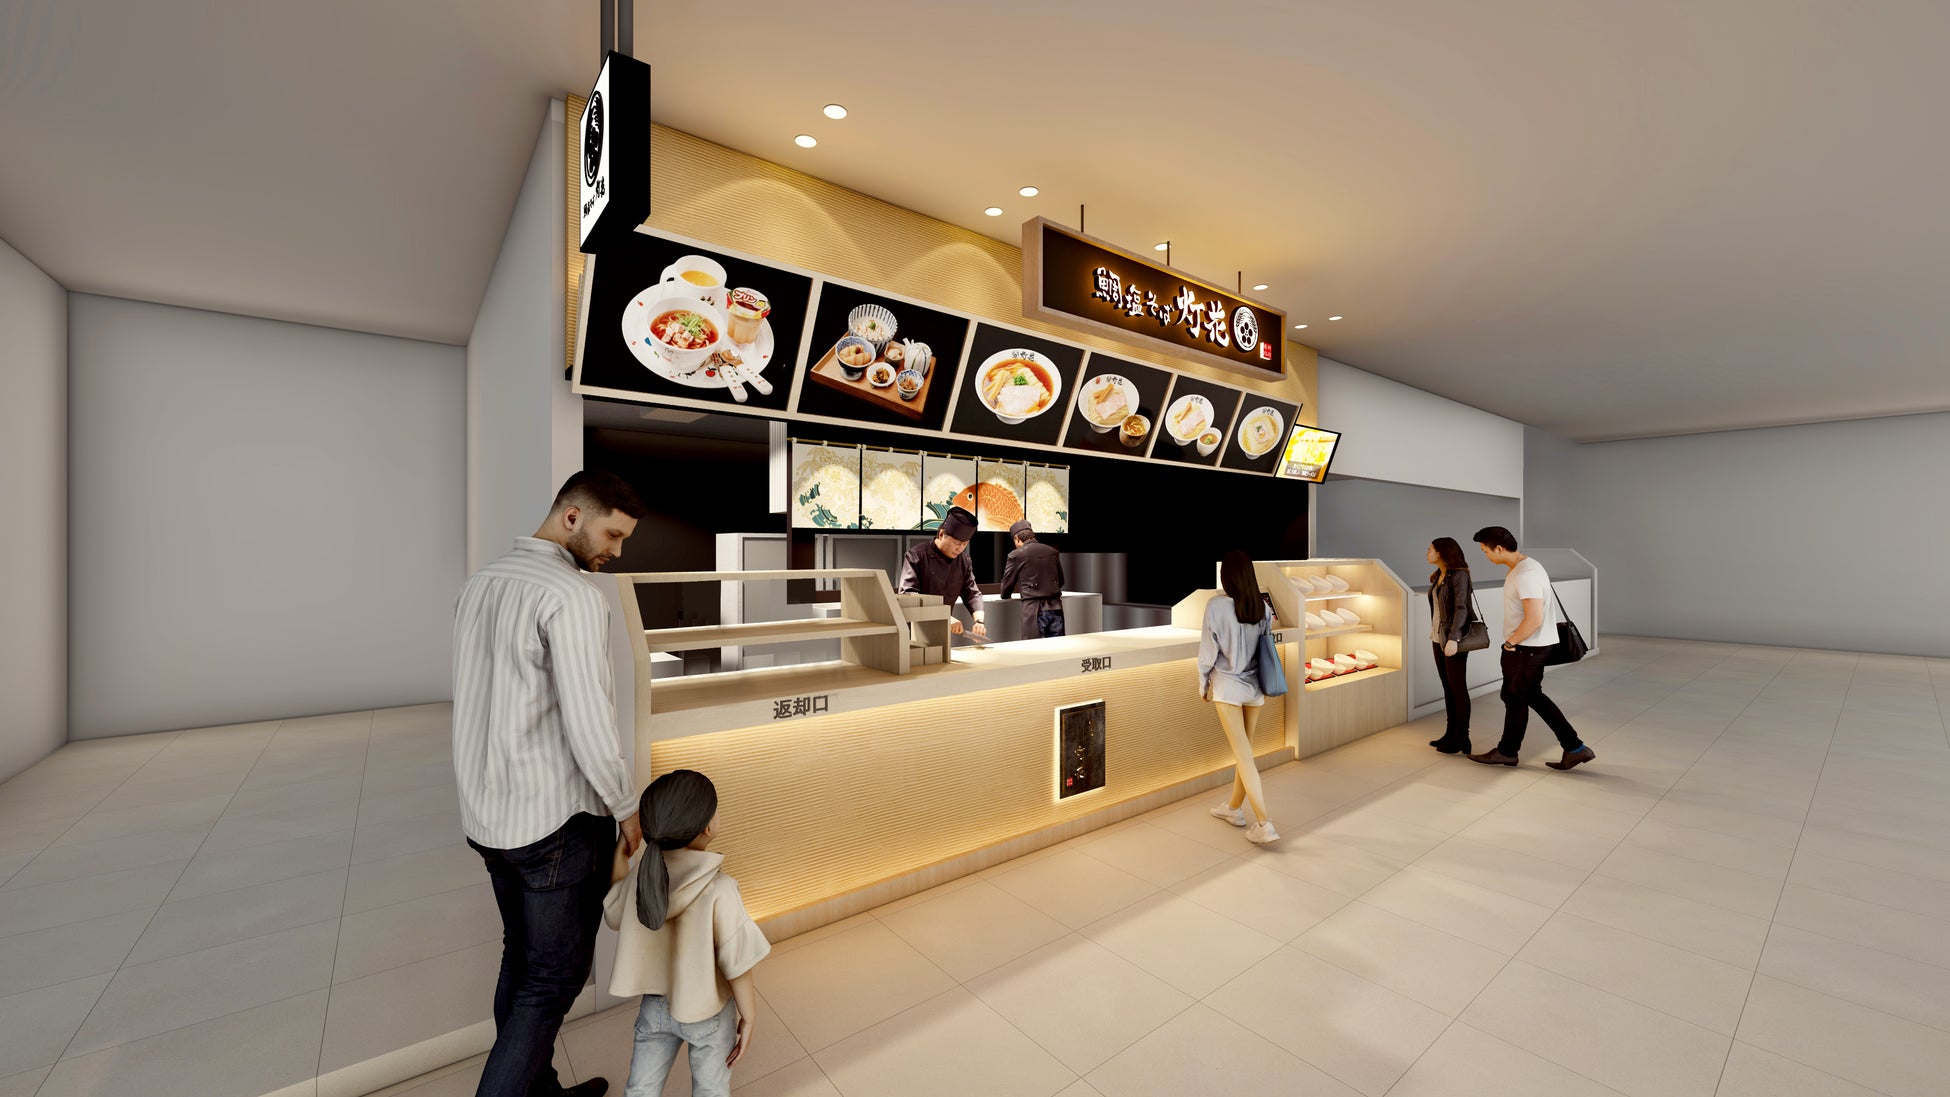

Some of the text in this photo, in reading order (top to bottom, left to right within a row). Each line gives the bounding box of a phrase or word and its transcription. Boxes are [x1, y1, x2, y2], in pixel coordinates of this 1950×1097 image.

[1081, 656, 1112, 673] 受取口
[773, 695, 829, 719] 返却口
